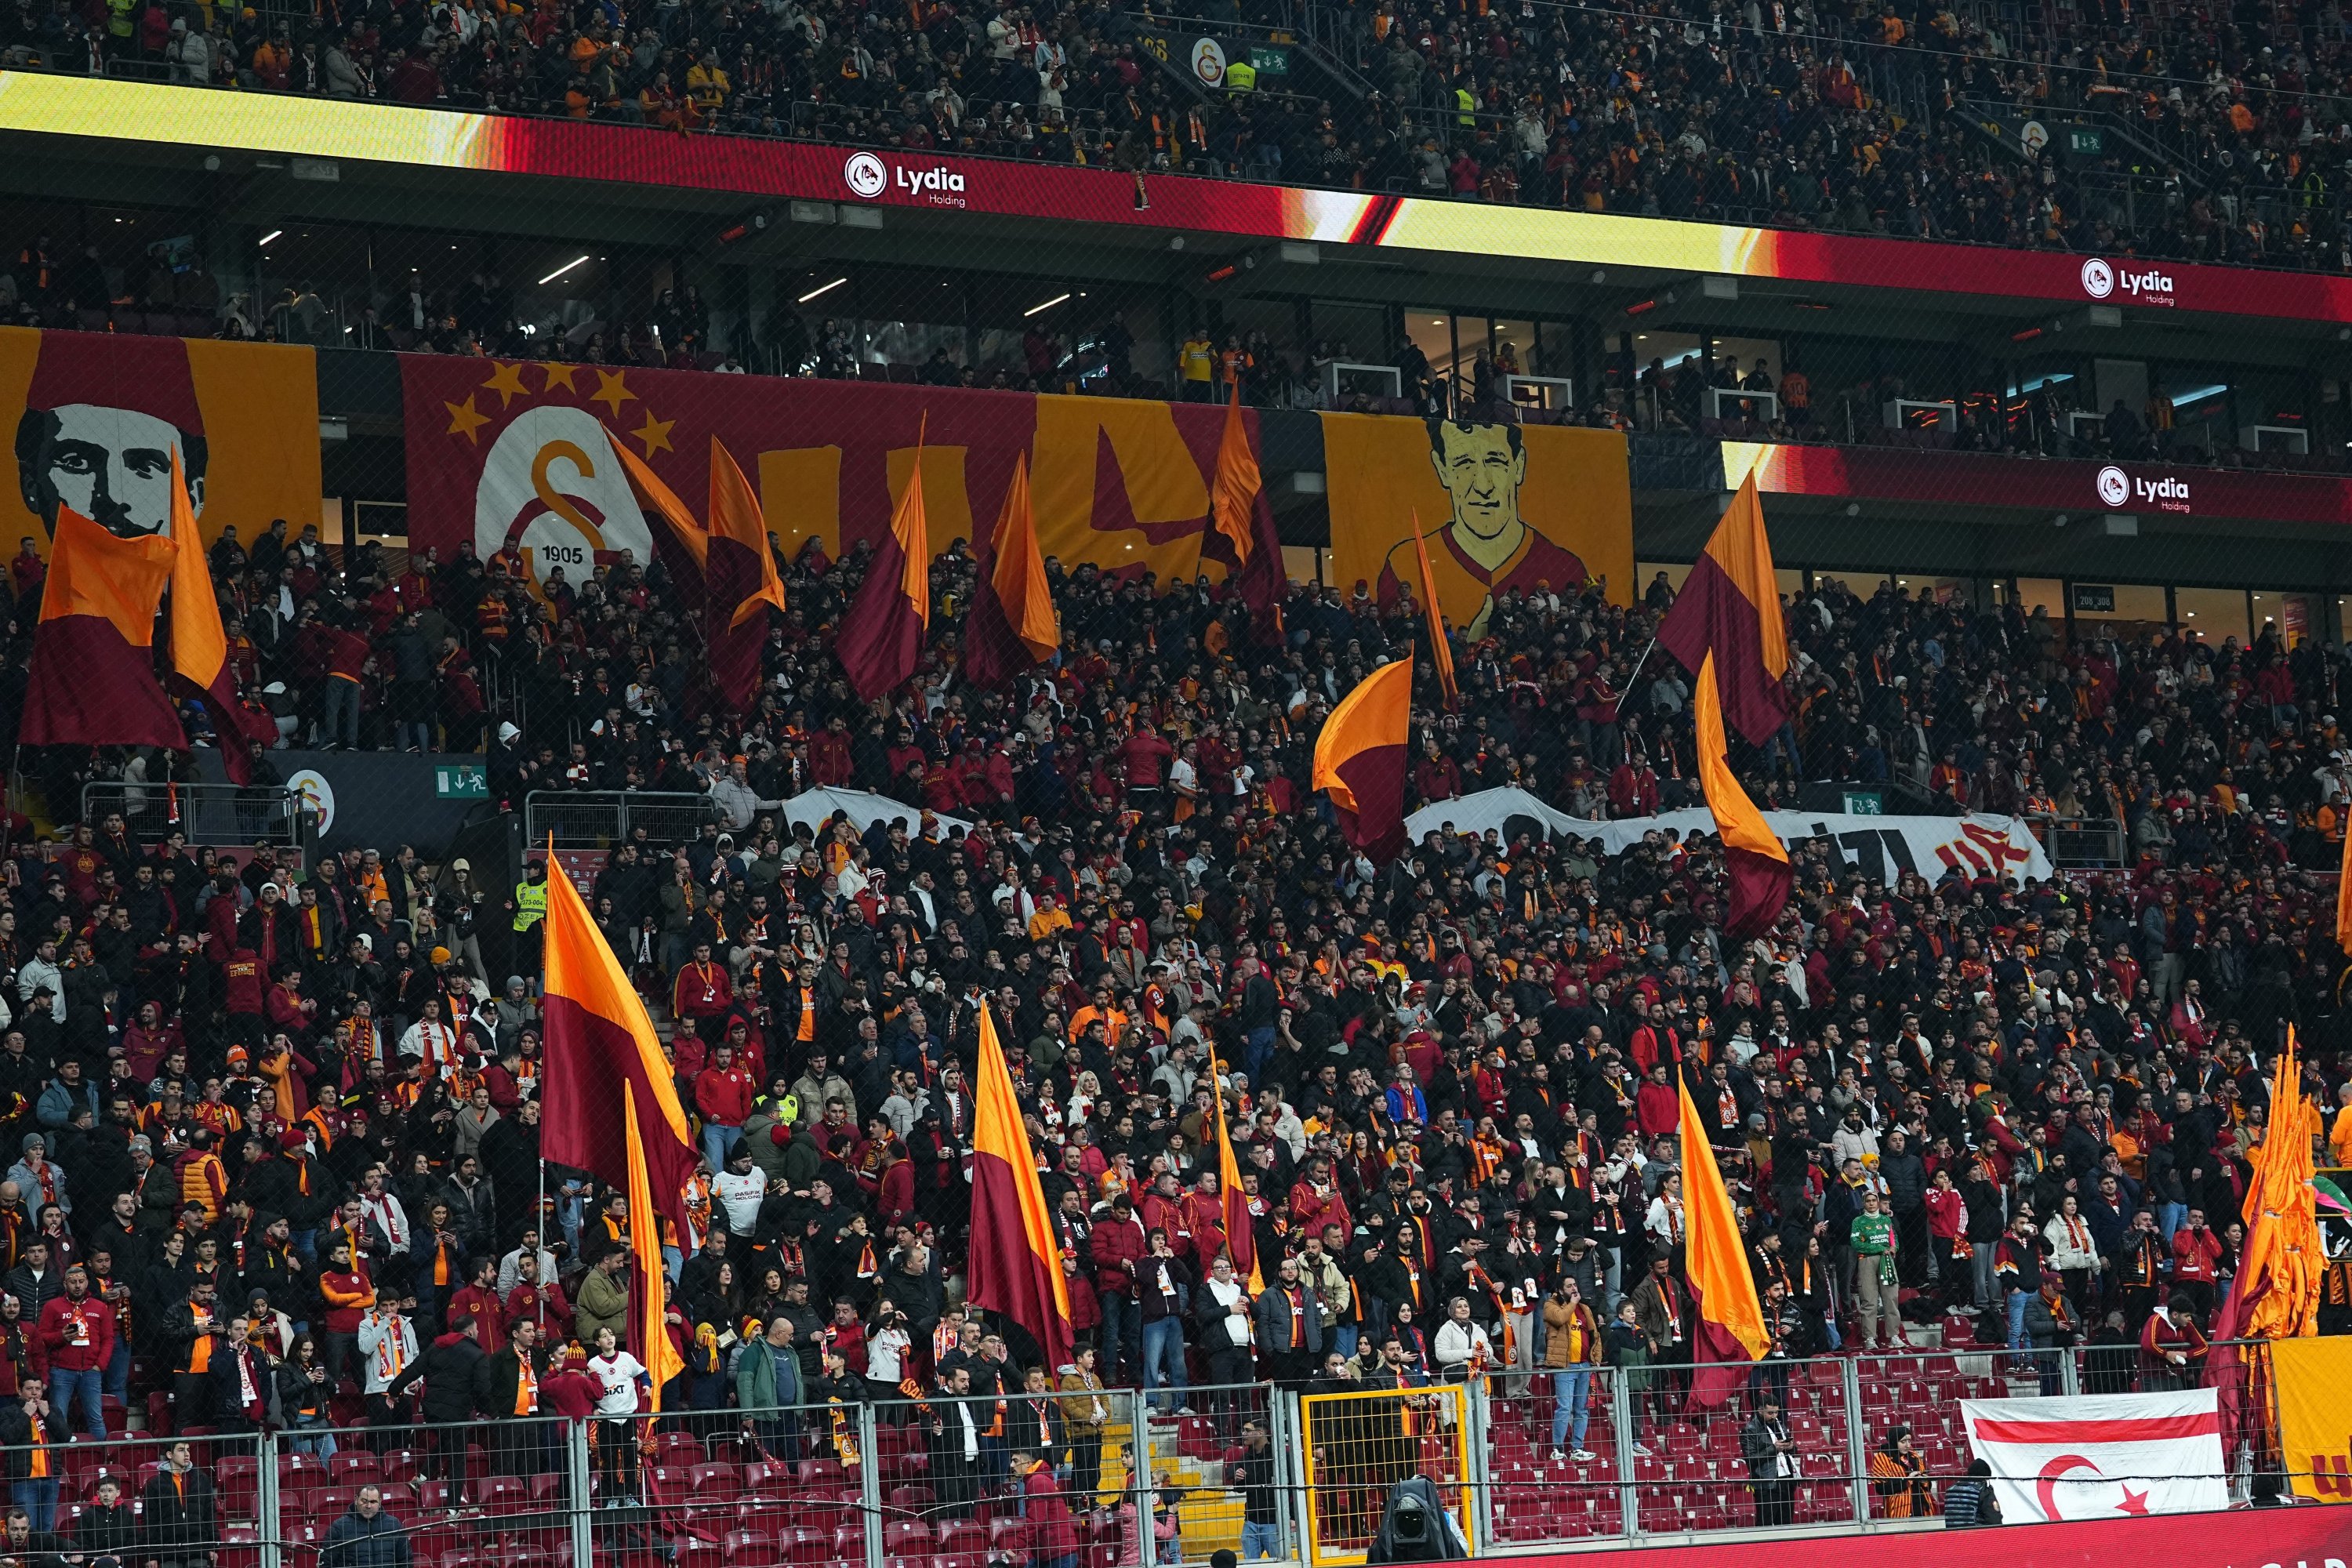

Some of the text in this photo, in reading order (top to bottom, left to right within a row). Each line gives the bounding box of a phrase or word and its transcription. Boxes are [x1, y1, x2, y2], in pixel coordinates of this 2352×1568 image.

[897, 165, 965, 195] Lydia
[929, 194, 966, 209] Holding
[2121, 270, 2173, 296] Lydia
[2146, 295, 2175, 306] Holding
[2136, 477, 2189, 503] Lydia
[2162, 502, 2190, 513] Holding
[543, 546, 583, 564] 1905
[452, 1013, 468, 1022] SIXT
[604, 1384, 624, 1396] SIXT
